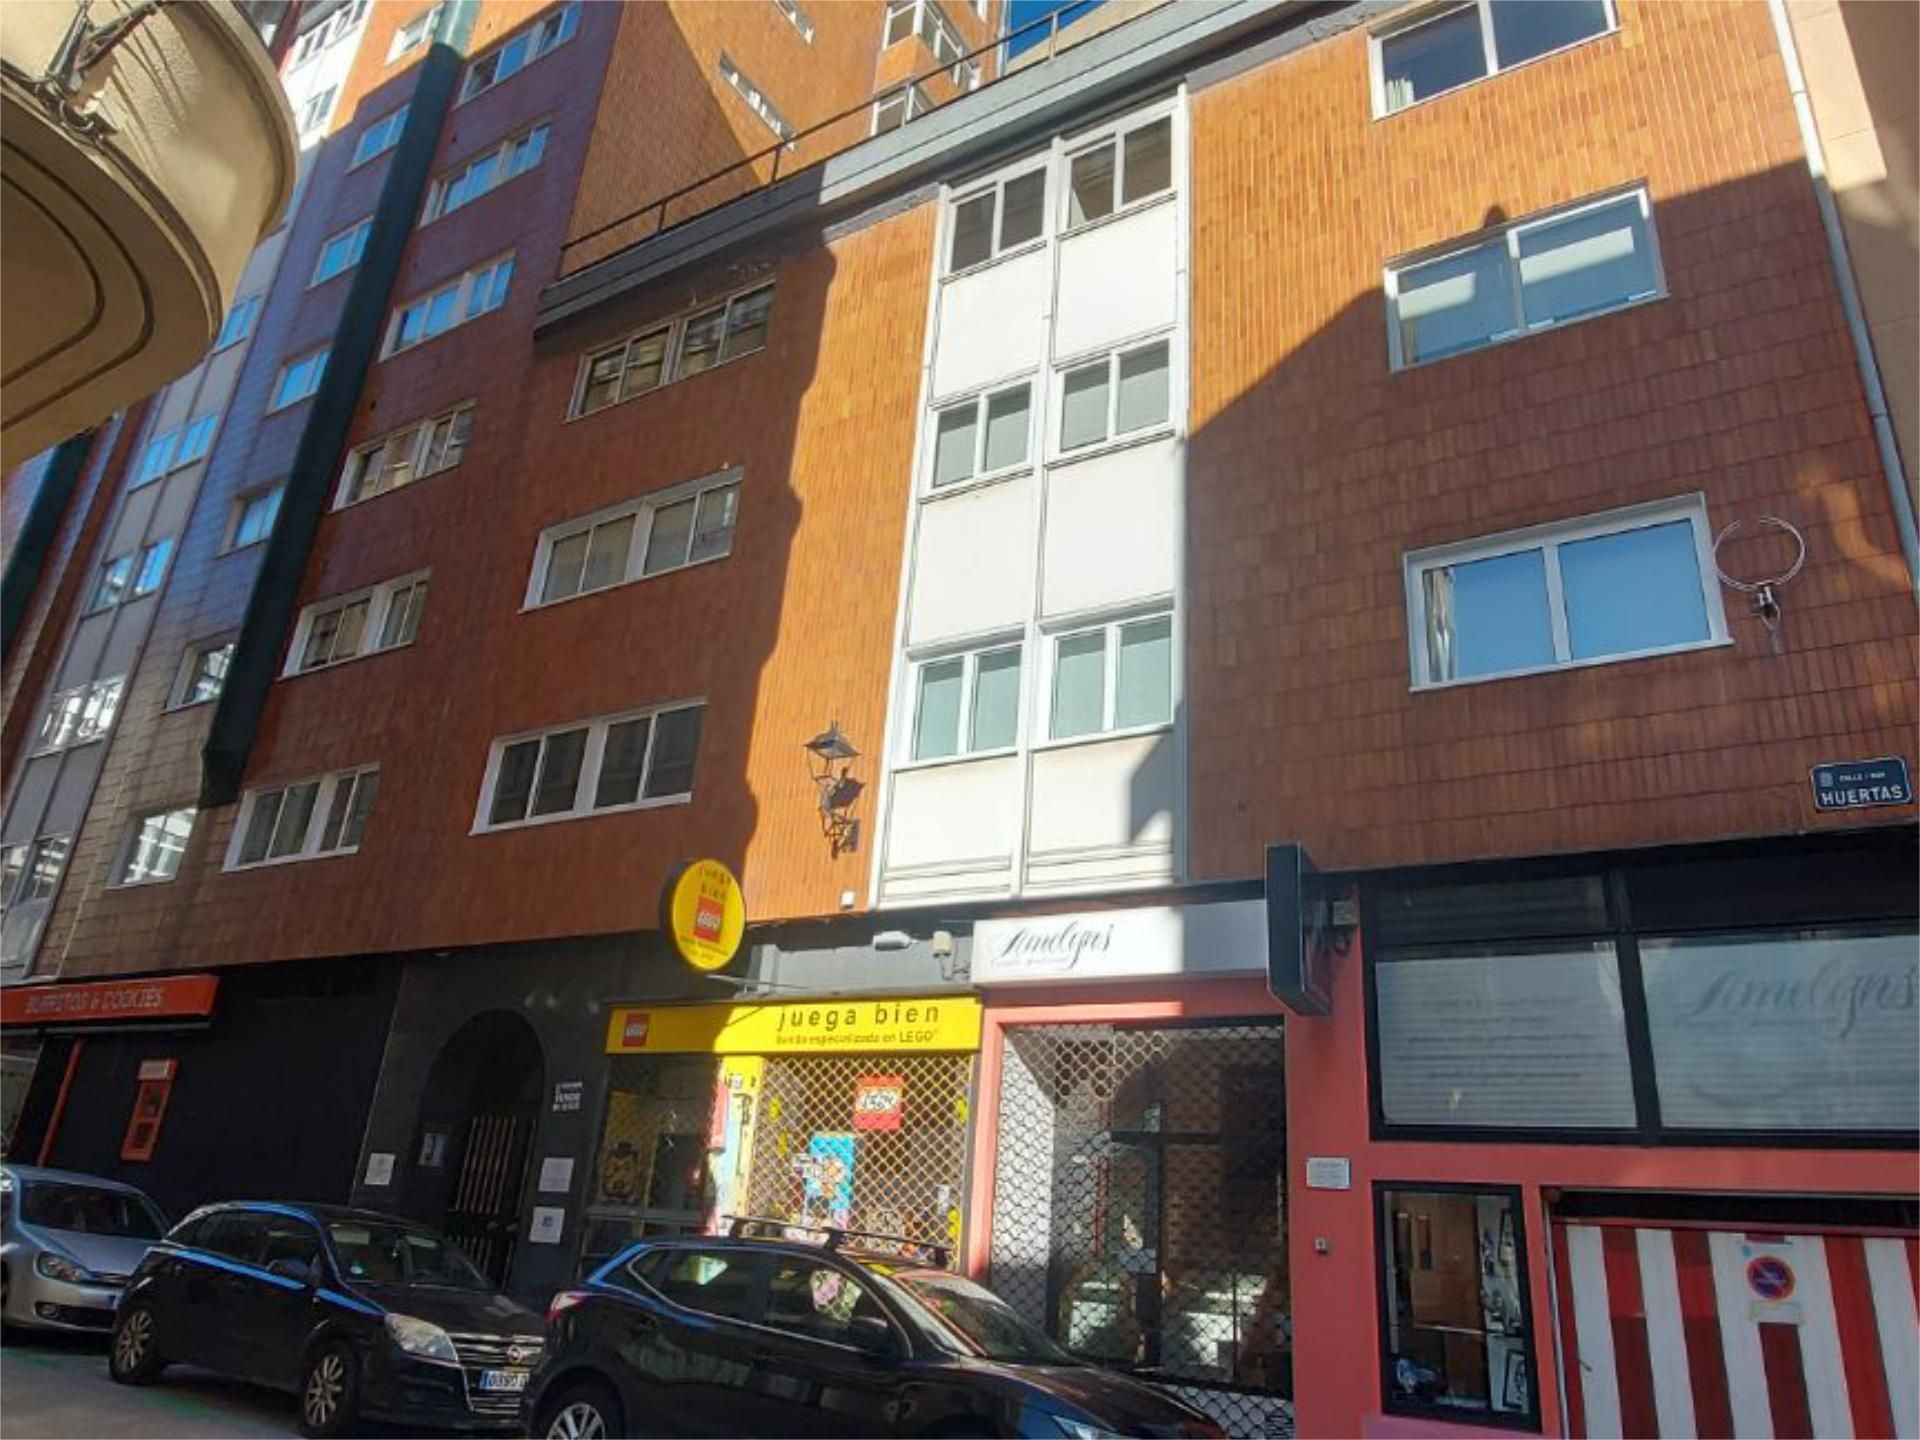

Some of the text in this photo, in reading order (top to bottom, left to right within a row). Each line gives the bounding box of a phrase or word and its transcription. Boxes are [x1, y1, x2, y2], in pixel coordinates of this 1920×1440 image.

[1821, 784, 1903, 805] HUERTAS
[776, 1003, 939, 1032] juega bien
